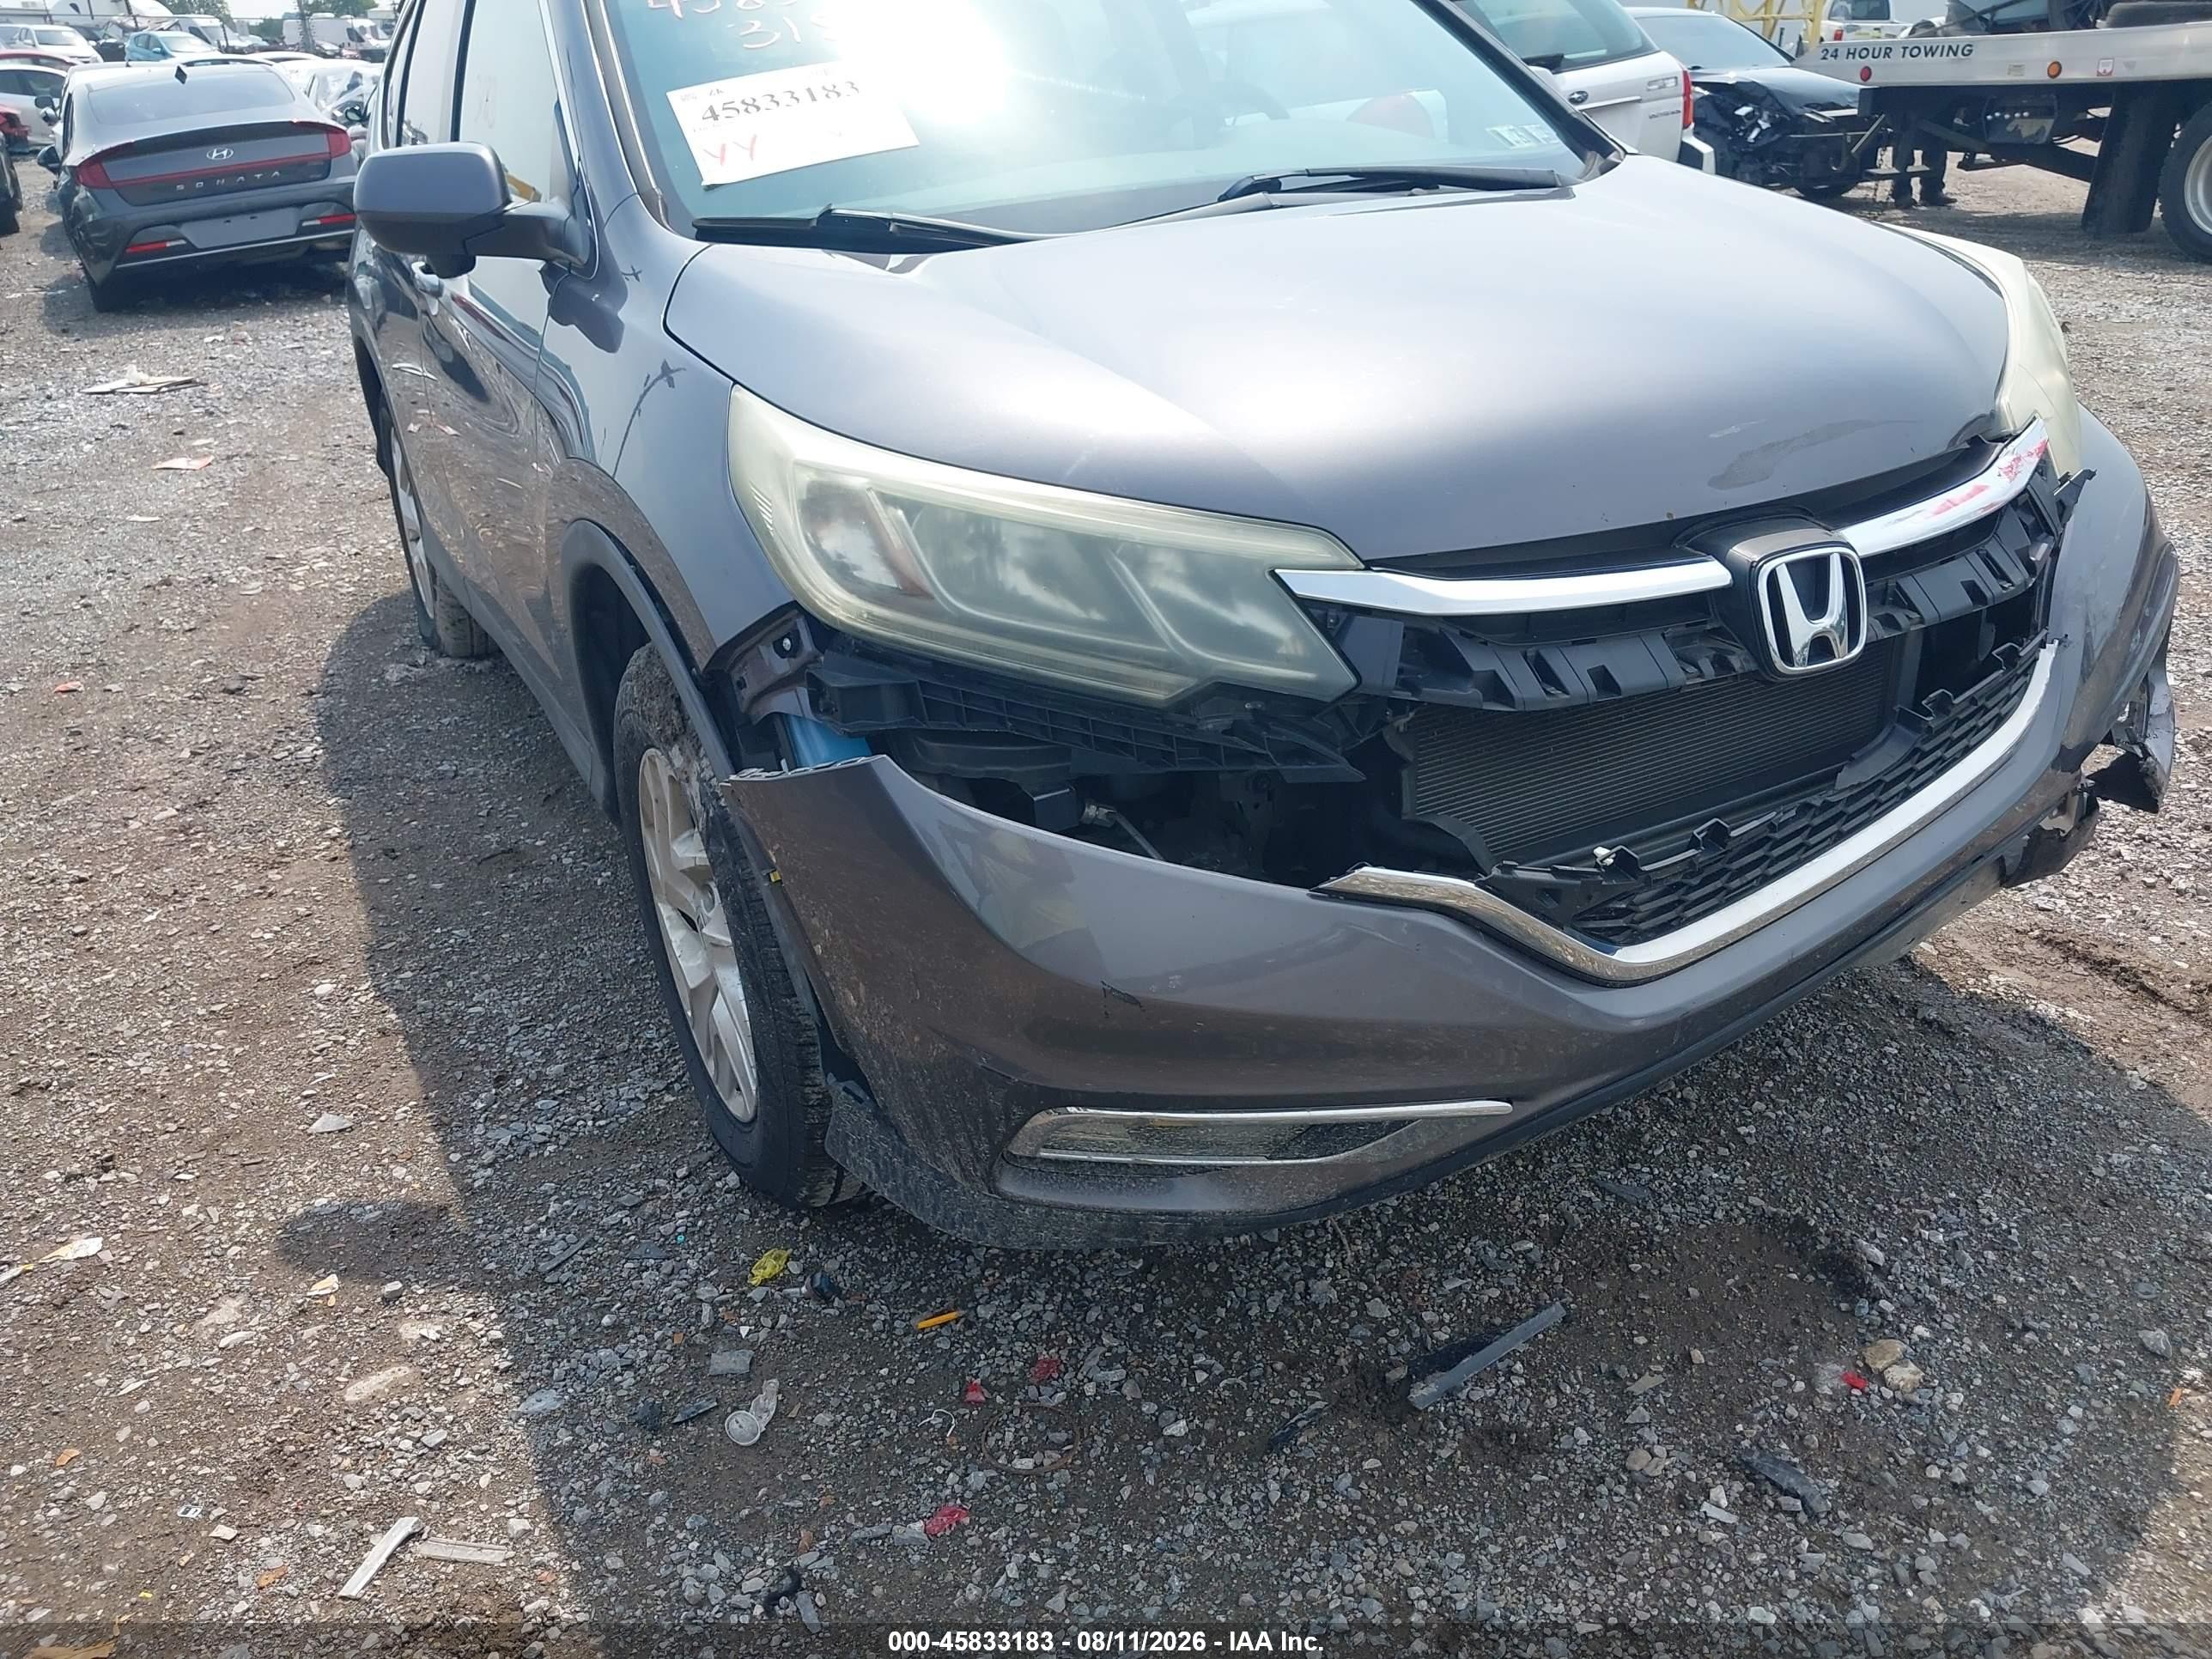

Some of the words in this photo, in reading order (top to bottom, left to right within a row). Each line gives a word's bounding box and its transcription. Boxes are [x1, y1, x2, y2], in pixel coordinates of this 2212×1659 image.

[1820, 47, 1838, 61] 24
[1845, 46, 1893, 60] HOUR
[1900, 44, 1973, 58] TOWING
[702, 81, 860, 122] 45833183
[176, 171, 281, 191] SONATA
